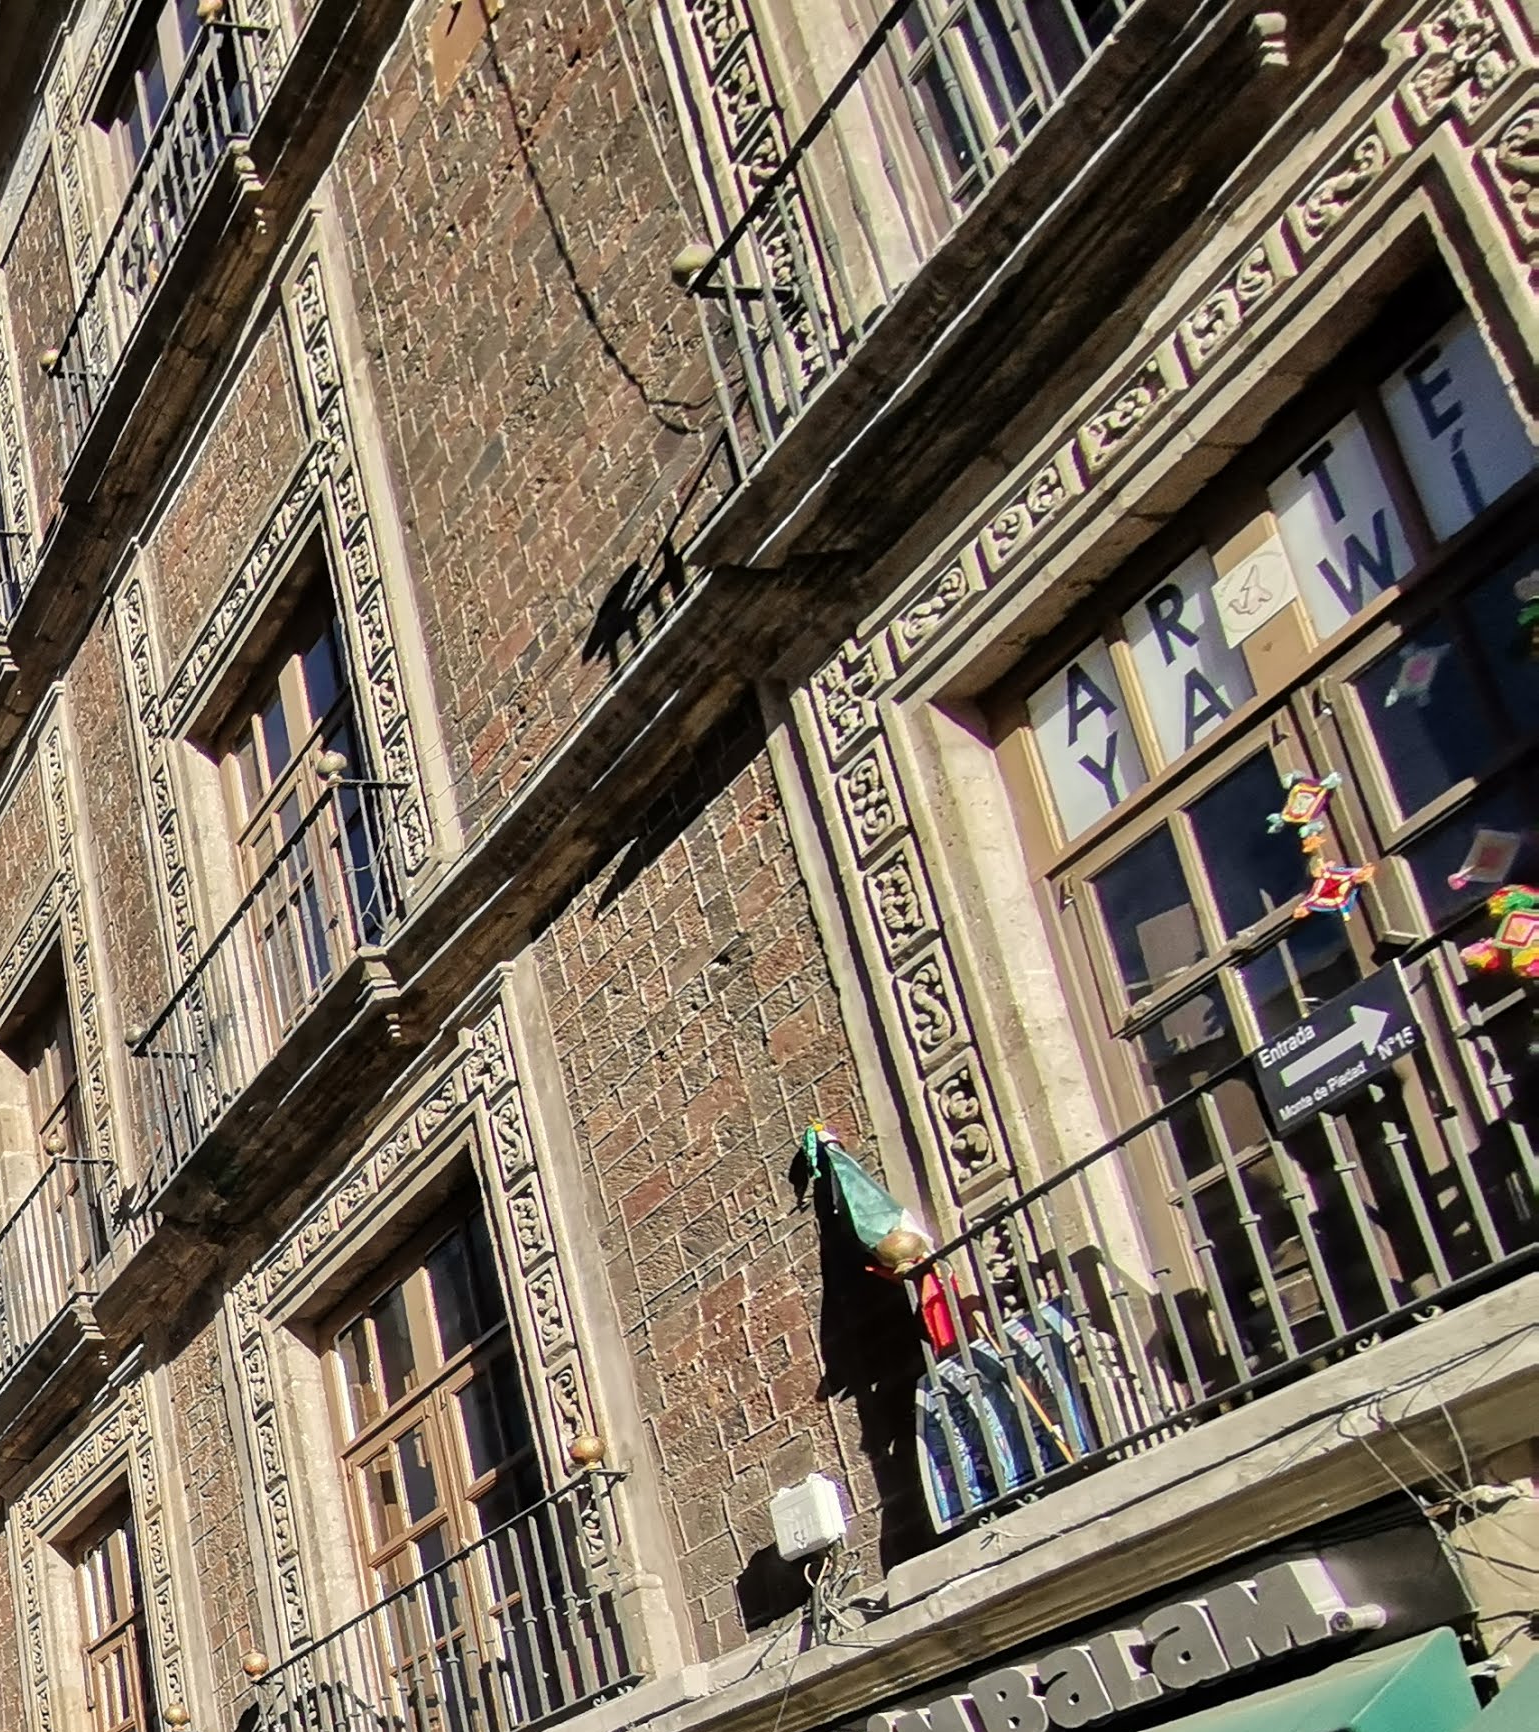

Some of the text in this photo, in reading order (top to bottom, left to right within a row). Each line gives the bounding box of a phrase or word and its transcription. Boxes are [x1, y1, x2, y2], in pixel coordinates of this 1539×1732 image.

[1257, 1023, 1317, 1070] Entrada
[1278, 1093, 1315, 1122] Monte
[1312, 1083, 1329, 1102] de
[1326, 1059, 1369, 1093] Piedad
